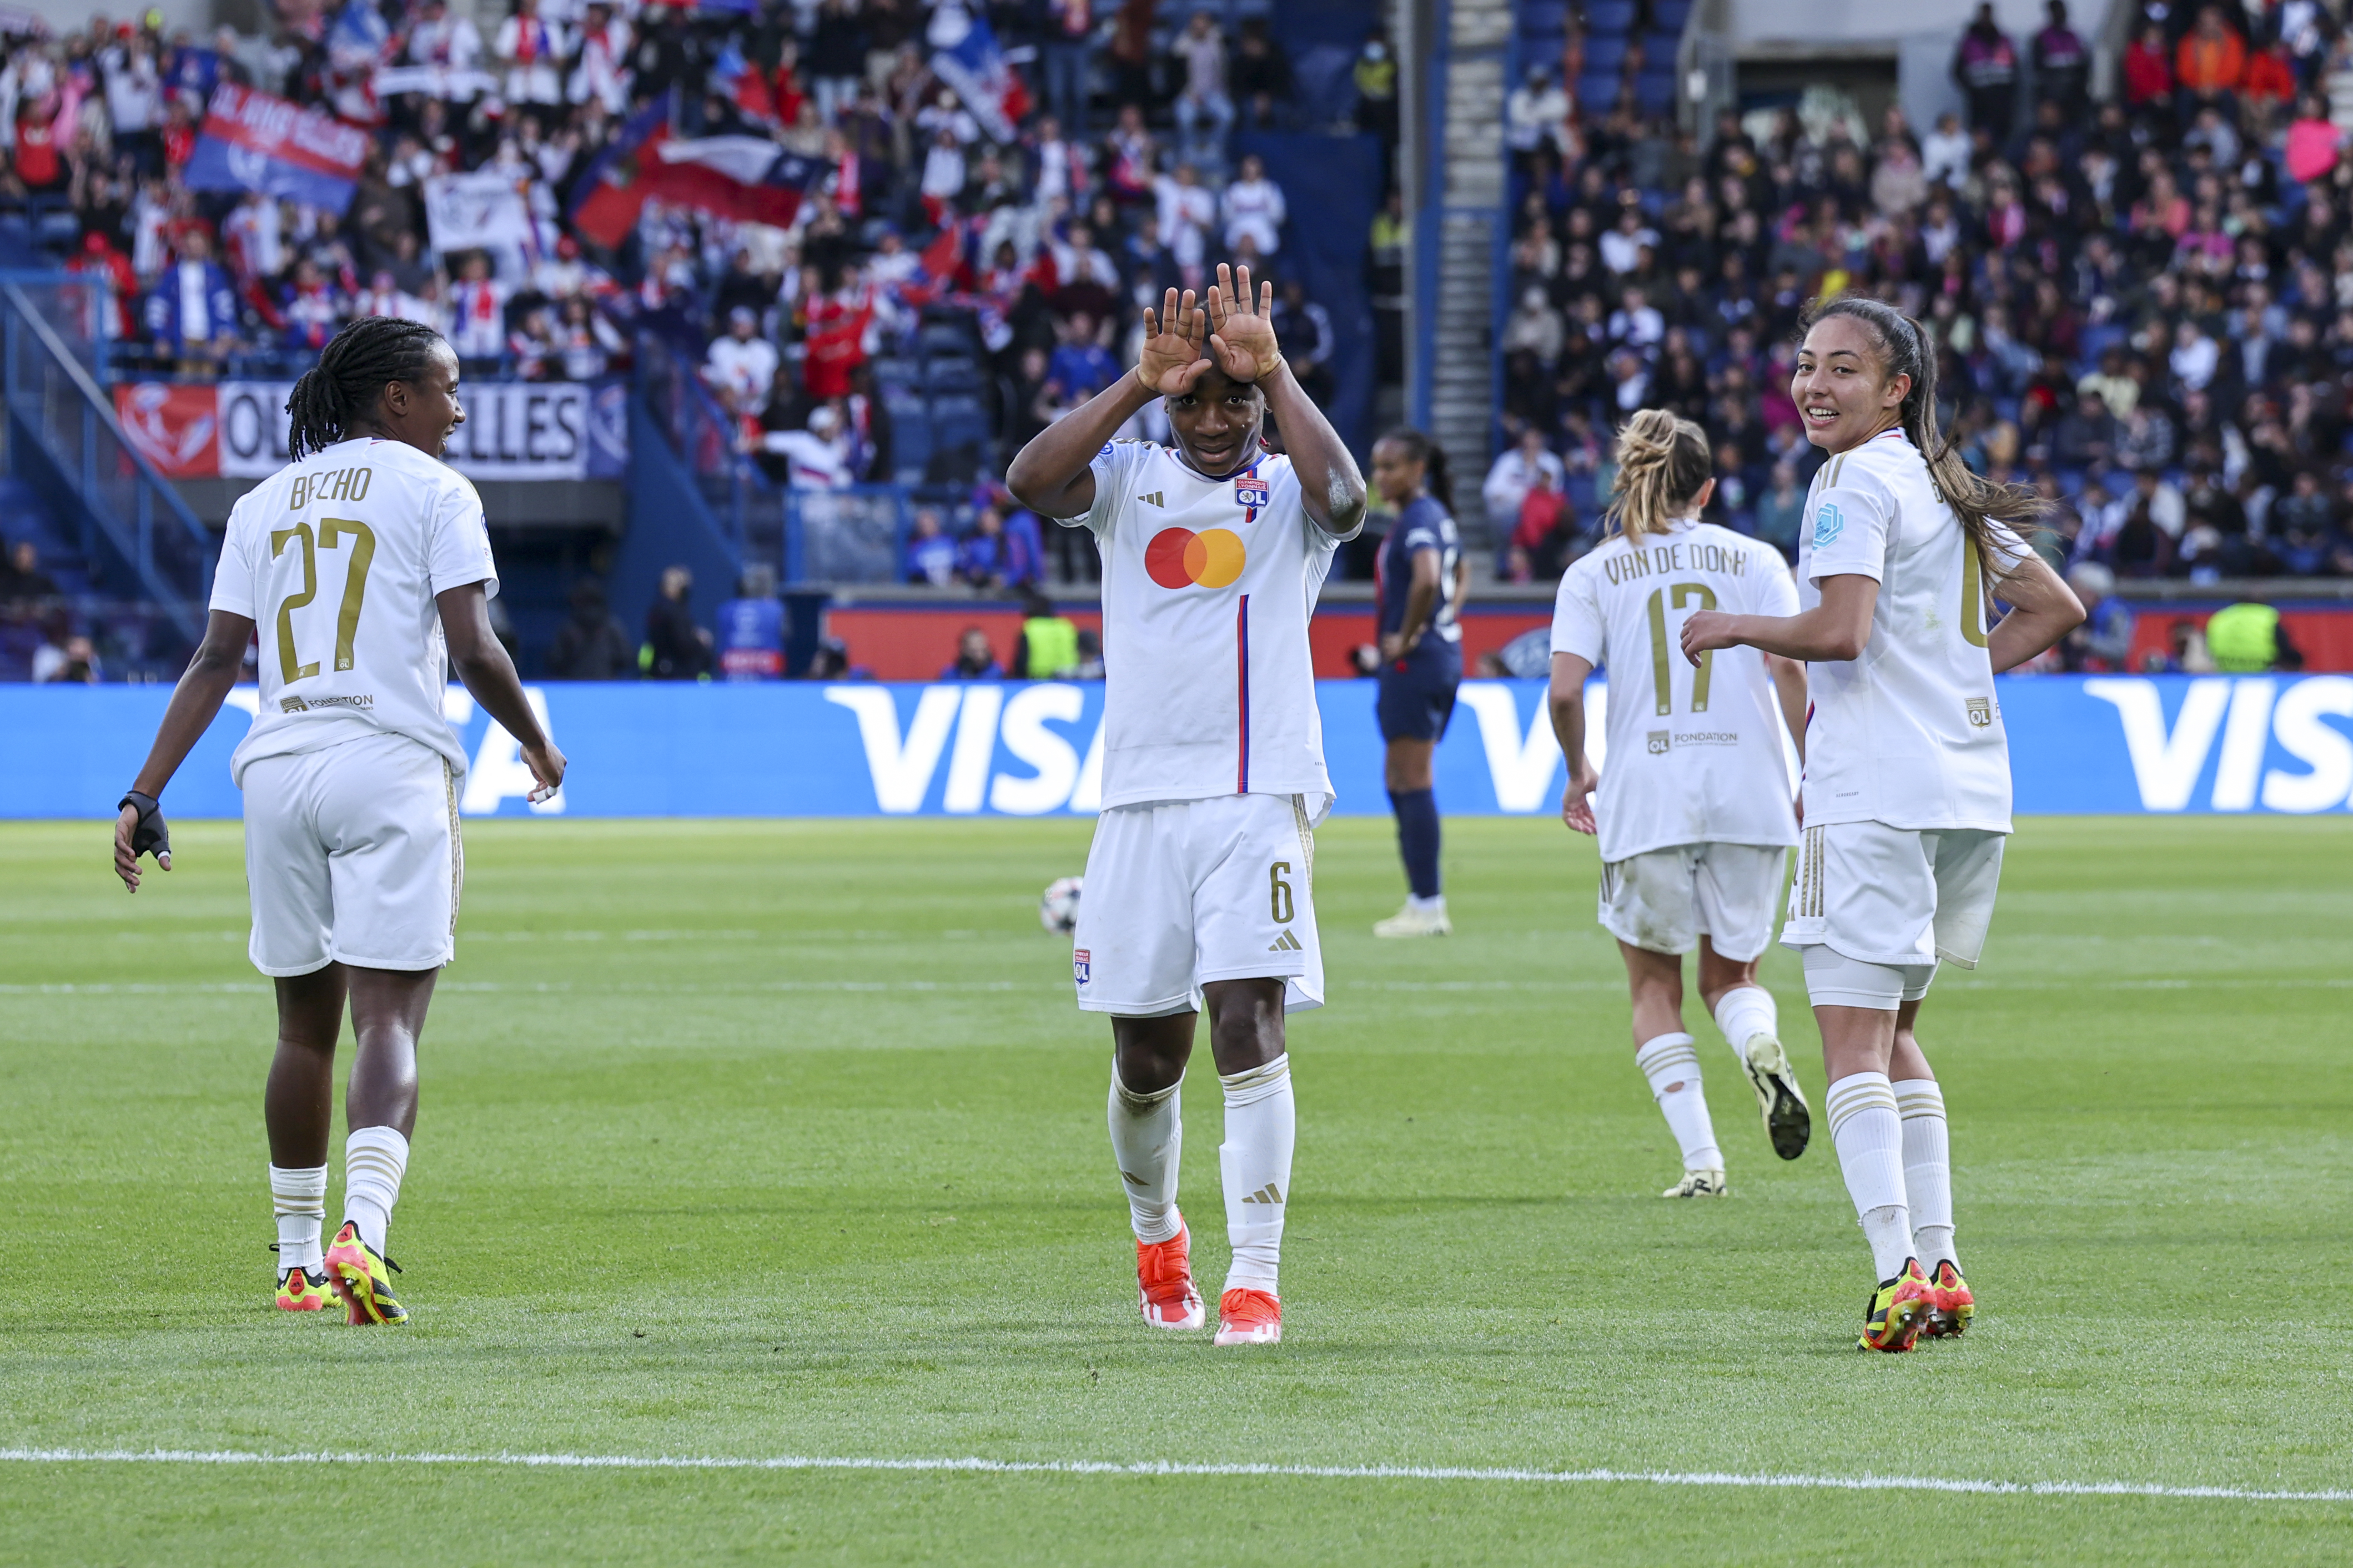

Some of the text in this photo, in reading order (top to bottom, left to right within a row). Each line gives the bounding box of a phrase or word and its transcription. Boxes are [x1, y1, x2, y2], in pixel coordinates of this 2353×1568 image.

[290, 467, 372, 511] BECHO
[1239, 490, 1265, 505] OL
[1604, 548, 1651, 586] VAN
[1654, 543, 1684, 574] DE
[270, 517, 376, 685] 27
[1647, 583, 1717, 716] 17
[1675, 733, 1737, 743] FONDATION
[1970, 710, 1989, 724] OL
[2082, 675, 2353, 814] VIS
[1270, 861, 1295, 924] 6
